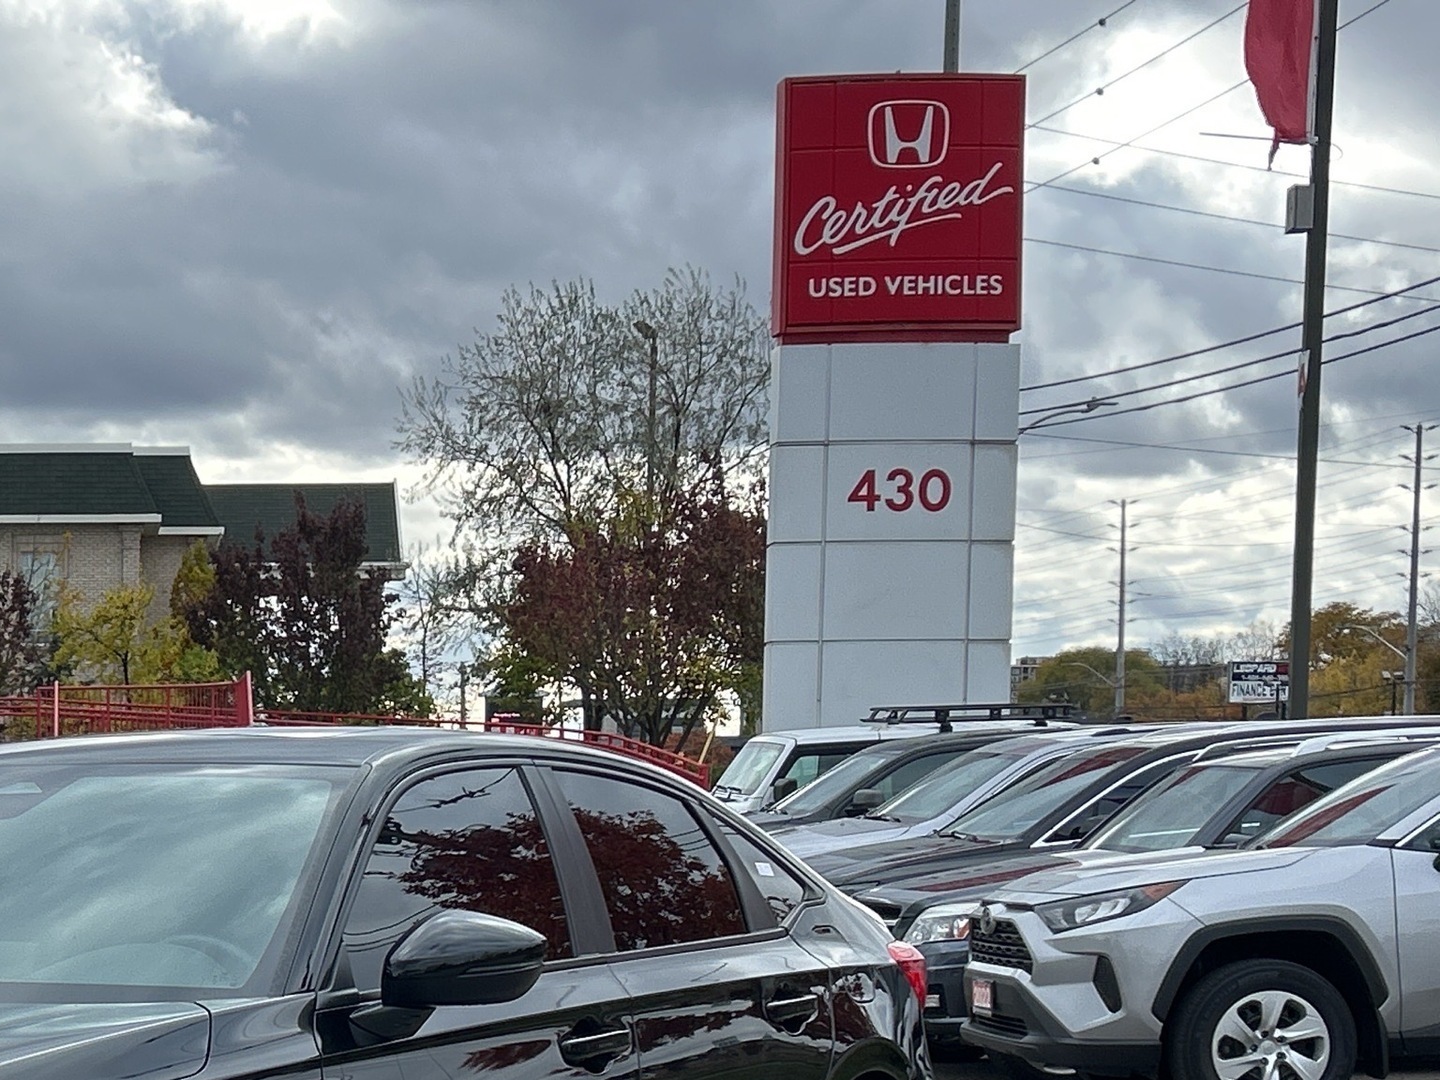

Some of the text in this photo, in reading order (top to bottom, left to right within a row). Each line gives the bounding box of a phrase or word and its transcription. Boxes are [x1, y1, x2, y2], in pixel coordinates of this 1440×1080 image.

[794, 161, 1014, 255] Certified
[808, 274, 1003, 298] USED VEHICLES
[846, 467, 953, 513] 430
